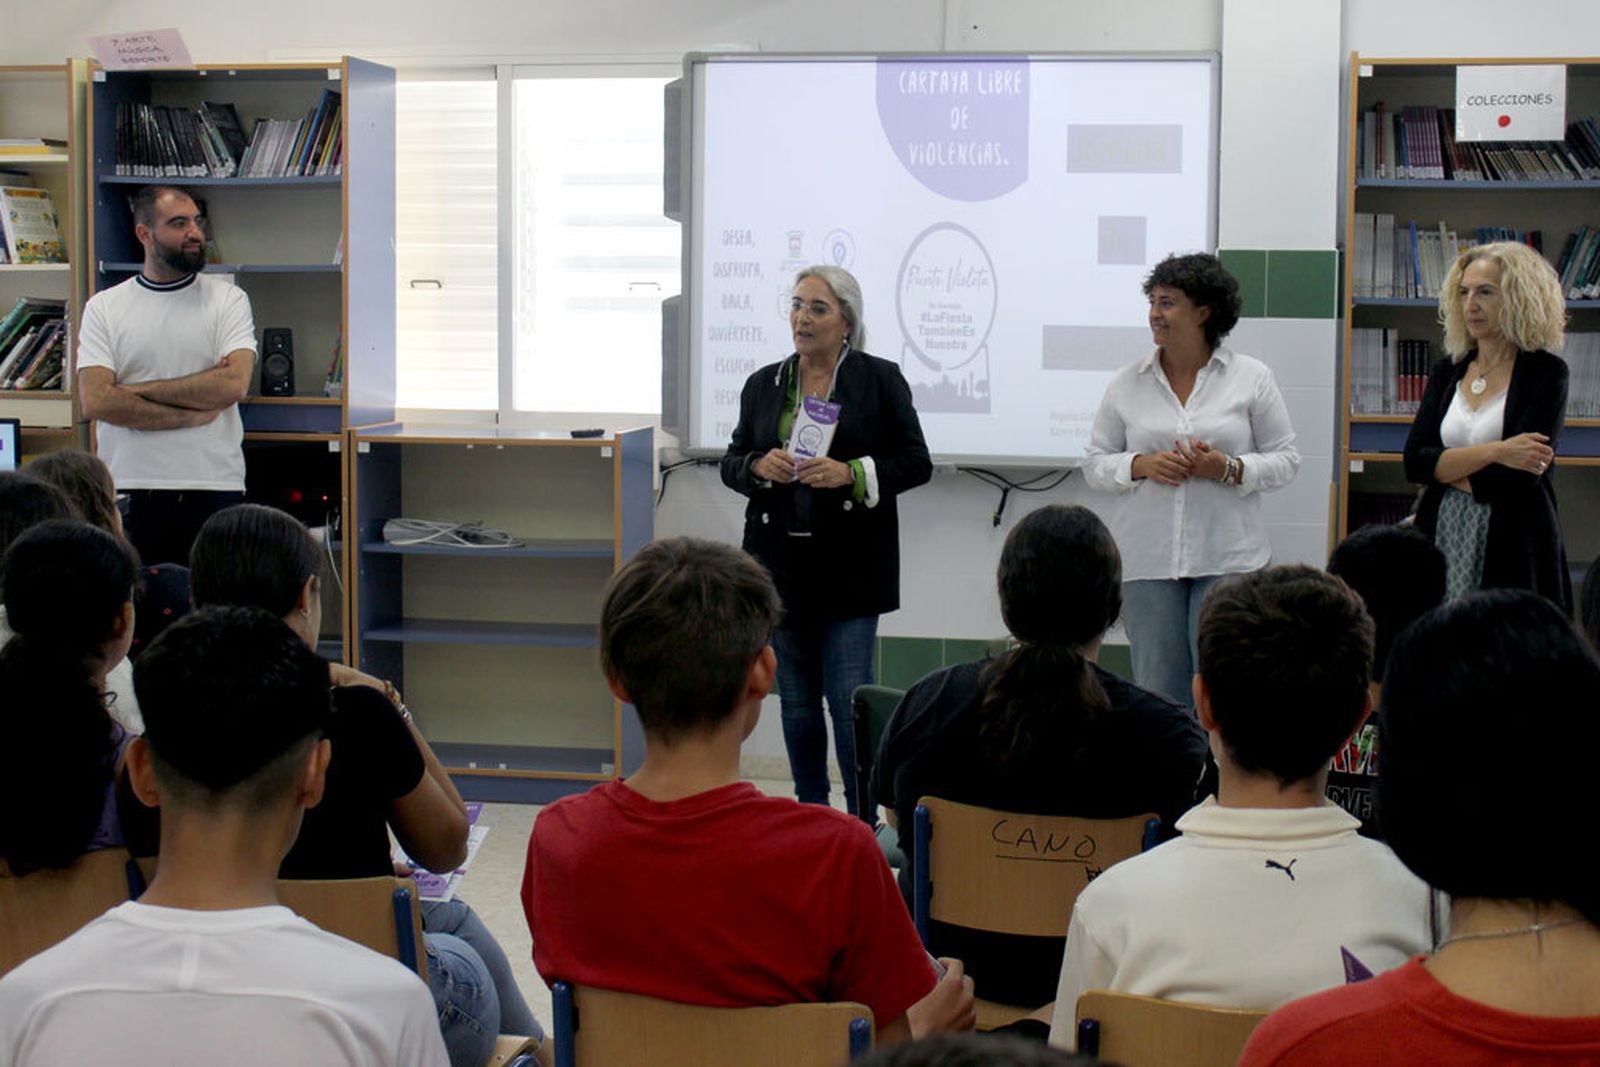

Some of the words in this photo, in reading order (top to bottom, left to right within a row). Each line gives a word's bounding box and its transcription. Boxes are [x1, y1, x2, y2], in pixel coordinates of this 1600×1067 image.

[899, 69, 968, 95] CARTAYA
[1466, 93, 1553, 106] COLECCIONES
[950, 106, 968, 130] DE
[920, 312, 973, 324] #LaFiesta
[924, 338, 968, 350] Nuestra
[991, 819, 1096, 858] CANO
